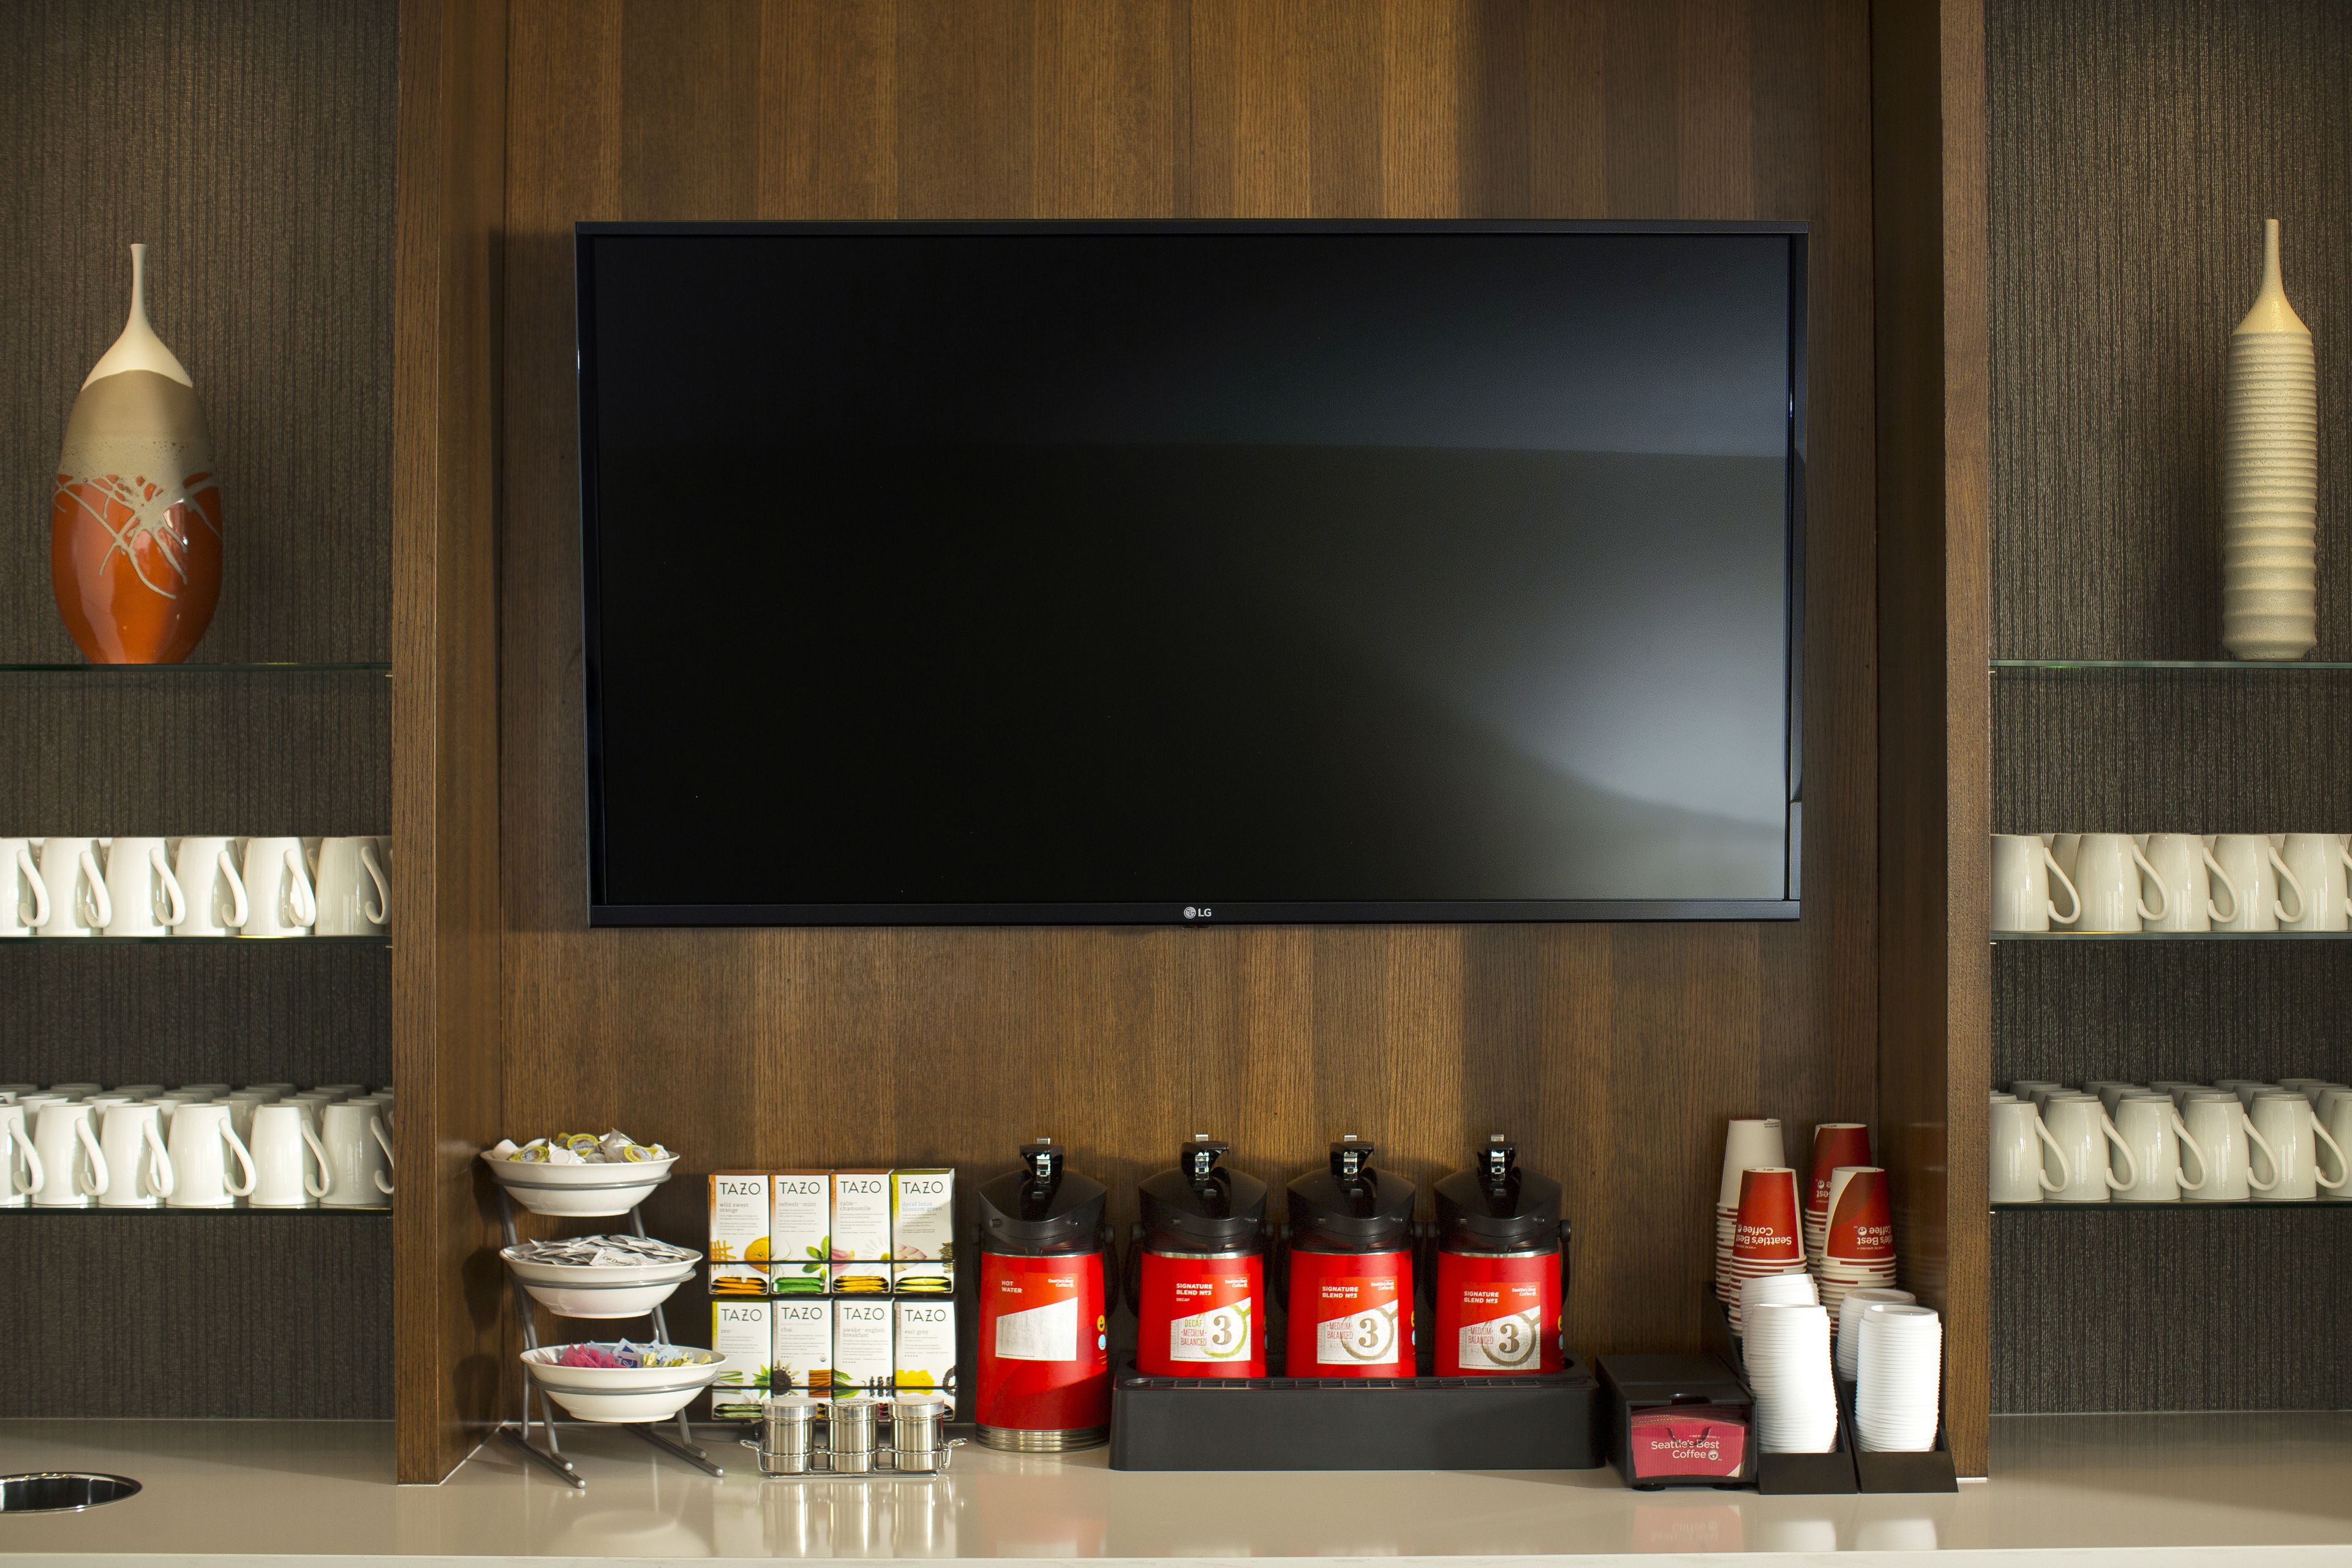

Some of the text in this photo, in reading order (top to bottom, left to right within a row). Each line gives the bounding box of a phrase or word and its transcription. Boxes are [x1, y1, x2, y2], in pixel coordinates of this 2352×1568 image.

[1198, 908, 1212, 917] LG
[719, 1183, 761, 1195] TAZO
[778, 1182, 820, 1194] TAZO
[840, 1181, 881, 1193] TAZO
[902, 1181, 943, 1194] TAZO
[1743, 1226, 1774, 1236] Coffee
[1869, 1225, 1891, 1235] Coffee
[1736, 1234, 1792, 1246] Seattle's Best
[1856, 1237, 1879, 1245] Best
[720, 1309, 762, 1321] TAZO
[781, 1307, 823, 1319] TAZO
[843, 1307, 884, 1320] TAZO
[905, 1309, 946, 1322] TAZO
[1212, 1315, 1232, 1346] 3
[1327, 1331, 1353, 1340] BALANCED
[1359, 1317, 1378, 1348] 3
[1180, 1338, 1207, 1346] BALANCED
[1468, 1335, 1494, 1344] BALANCED
[1499, 1323, 1520, 1354] 3
[1651, 1439, 1720, 1450] Seattle's Best
[1672, 1449, 1706, 1459] Coffee
